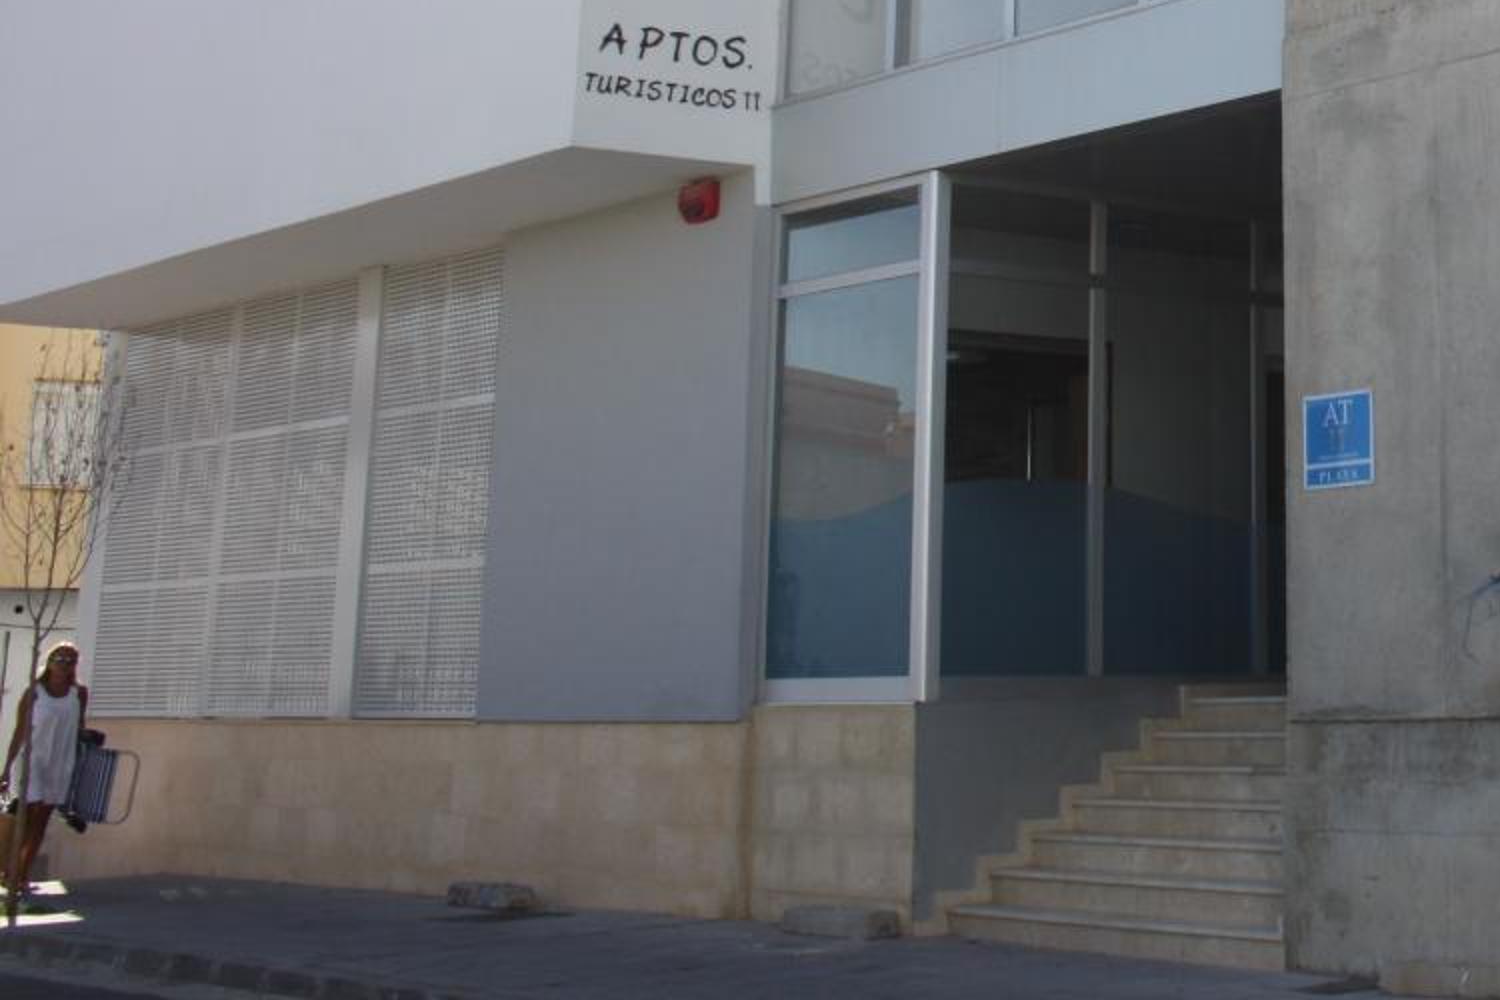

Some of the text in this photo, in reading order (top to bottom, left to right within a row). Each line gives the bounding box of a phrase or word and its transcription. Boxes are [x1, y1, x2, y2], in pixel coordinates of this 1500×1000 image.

[598, 22, 753, 70] APTOS.
[585, 71, 737, 110] TURISTICOS
[1321, 399, 1353, 428] AT
